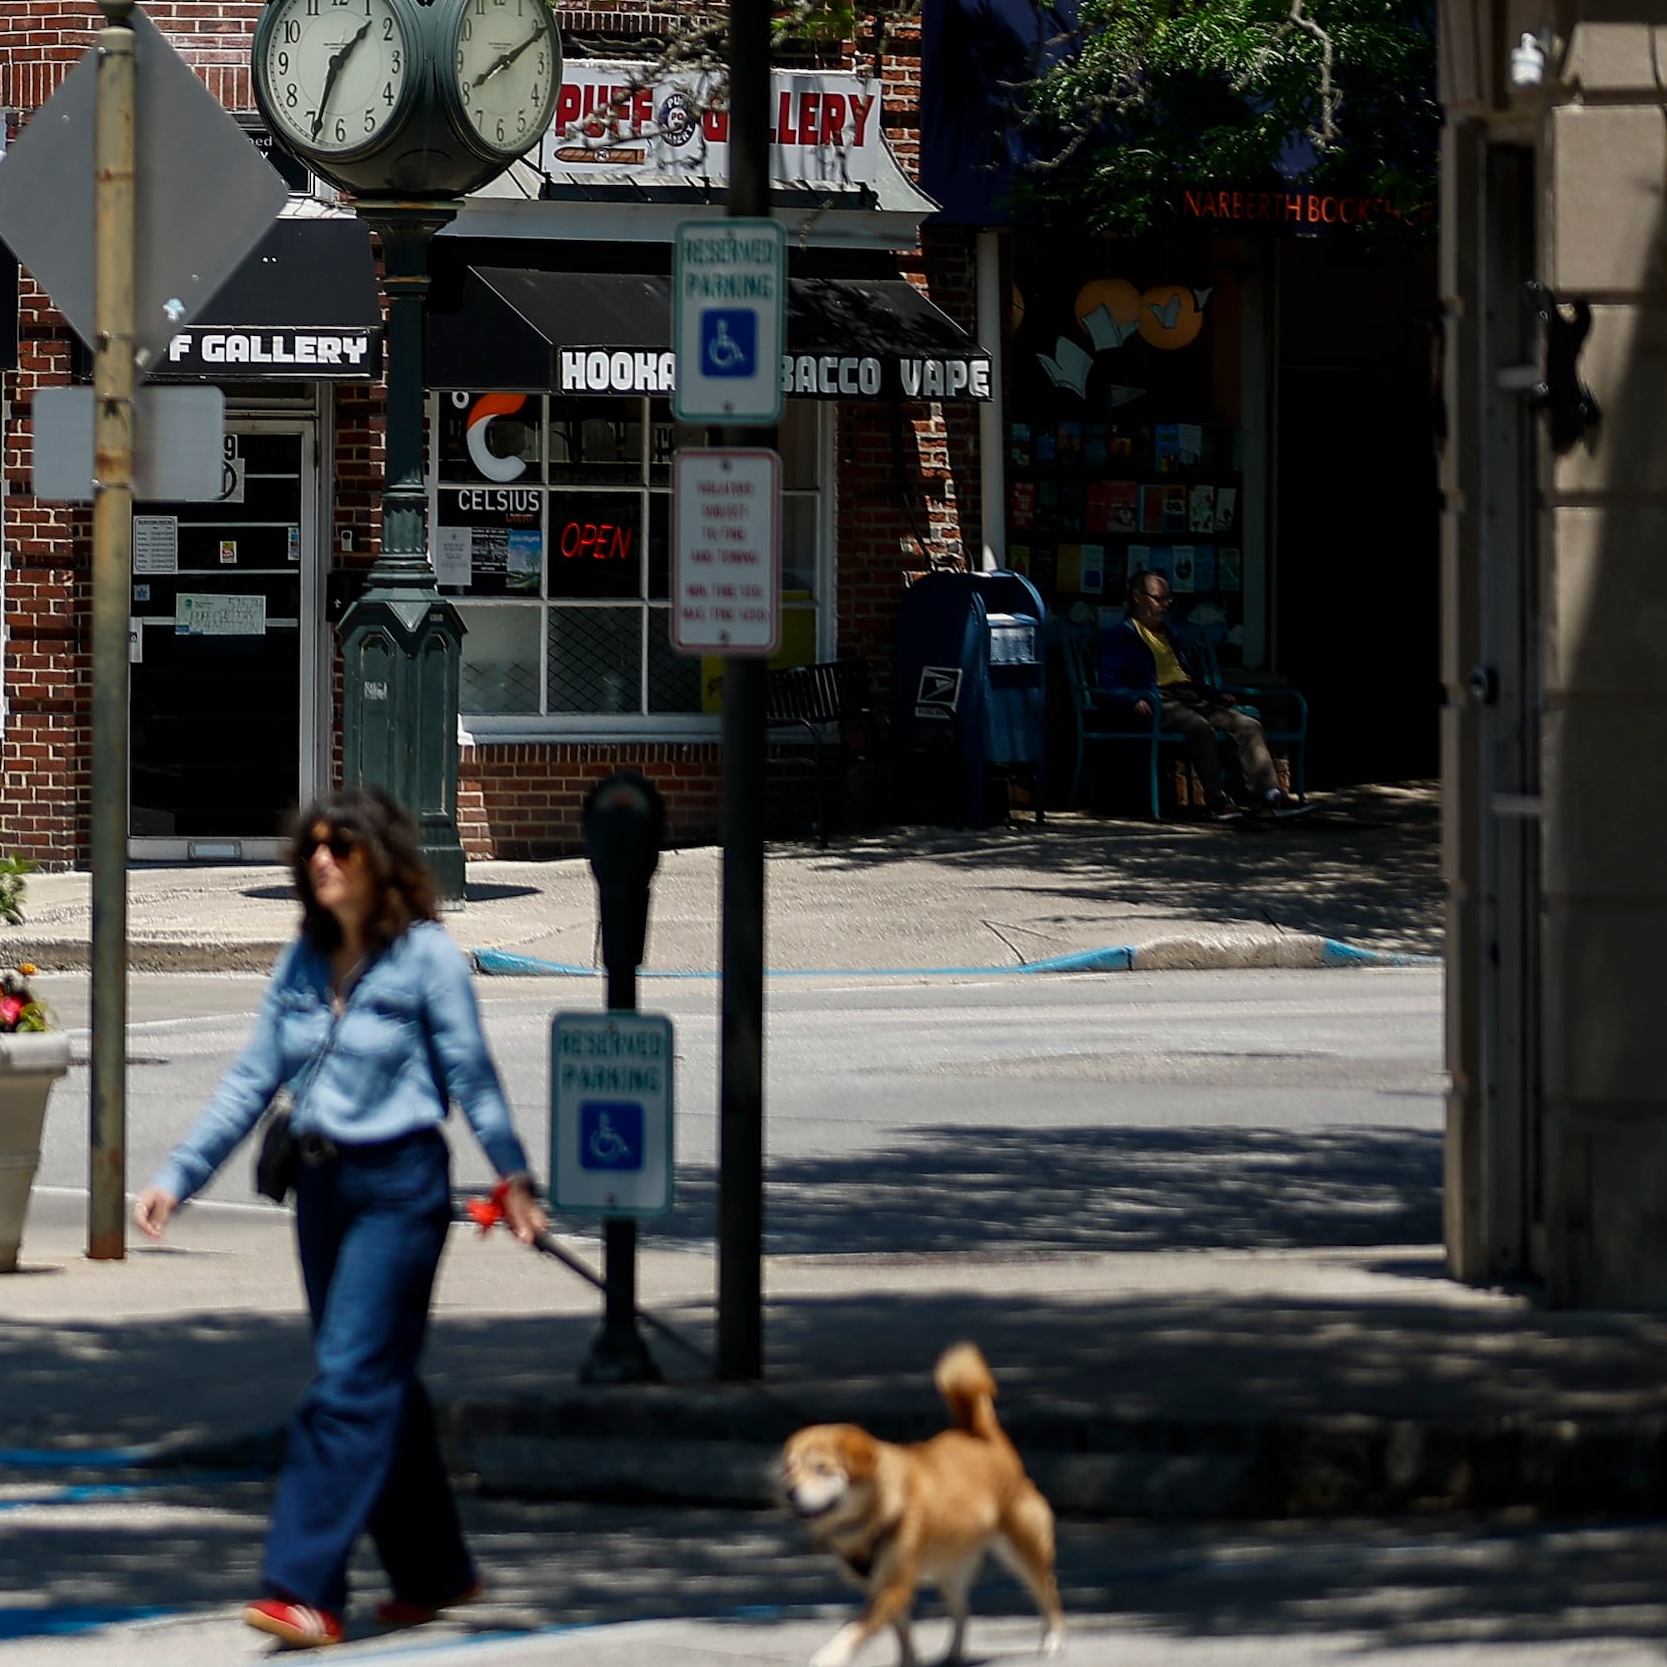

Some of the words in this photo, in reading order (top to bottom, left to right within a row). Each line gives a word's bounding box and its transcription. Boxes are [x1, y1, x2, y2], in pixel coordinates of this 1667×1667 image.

[283, 20, 301, 43] 10
[383, 18, 393, 40] 2
[278, 51, 288, 75] 9
[391, 50, 400, 74] 3
[286, 83, 298, 108] 8
[382, 82, 394, 106] 4
[335, 118, 346, 142] 6
[364, 108, 376, 132] 5
[496, 118, 505, 142] 6
[685, 273, 773, 298] PARKING
[201, 335, 367, 364] GALLERY
[561, 351, 676, 391] HOOKA
[781, 355, 882, 396] BACCO
[899, 358, 990, 397] VAPE
[458, 490, 540, 512] CELSIUS
[561, 522, 633, 559] OPEN
[563, 1066, 661, 1091] PARKING
